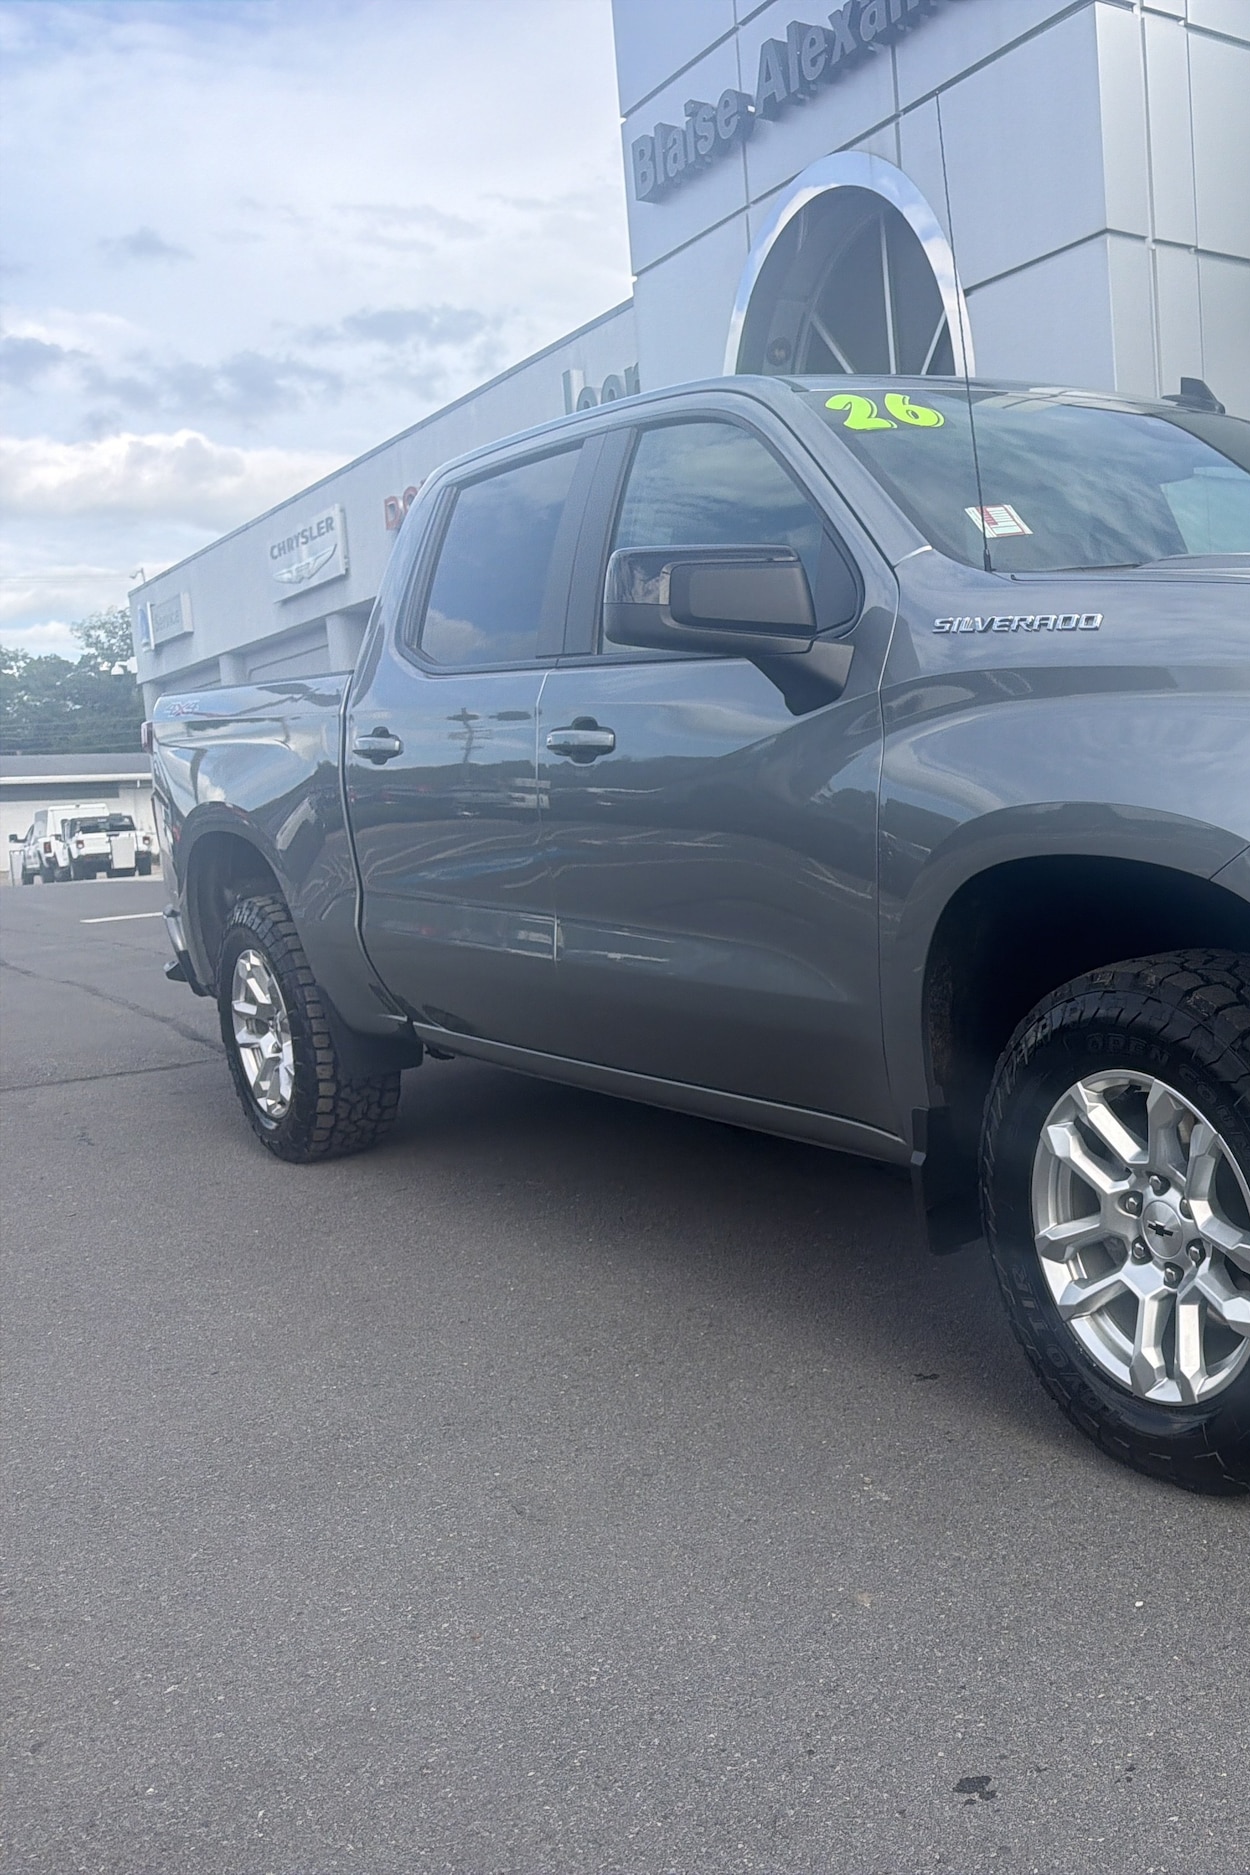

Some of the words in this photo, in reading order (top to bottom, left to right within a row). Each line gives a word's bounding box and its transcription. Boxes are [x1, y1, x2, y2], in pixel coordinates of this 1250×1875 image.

[632, 88, 748, 200] Blaise
[825, 393, 945, 430] 26
[269, 516, 335, 560] CHRYSLER
[932, 613, 1104, 633] SILVERADO
